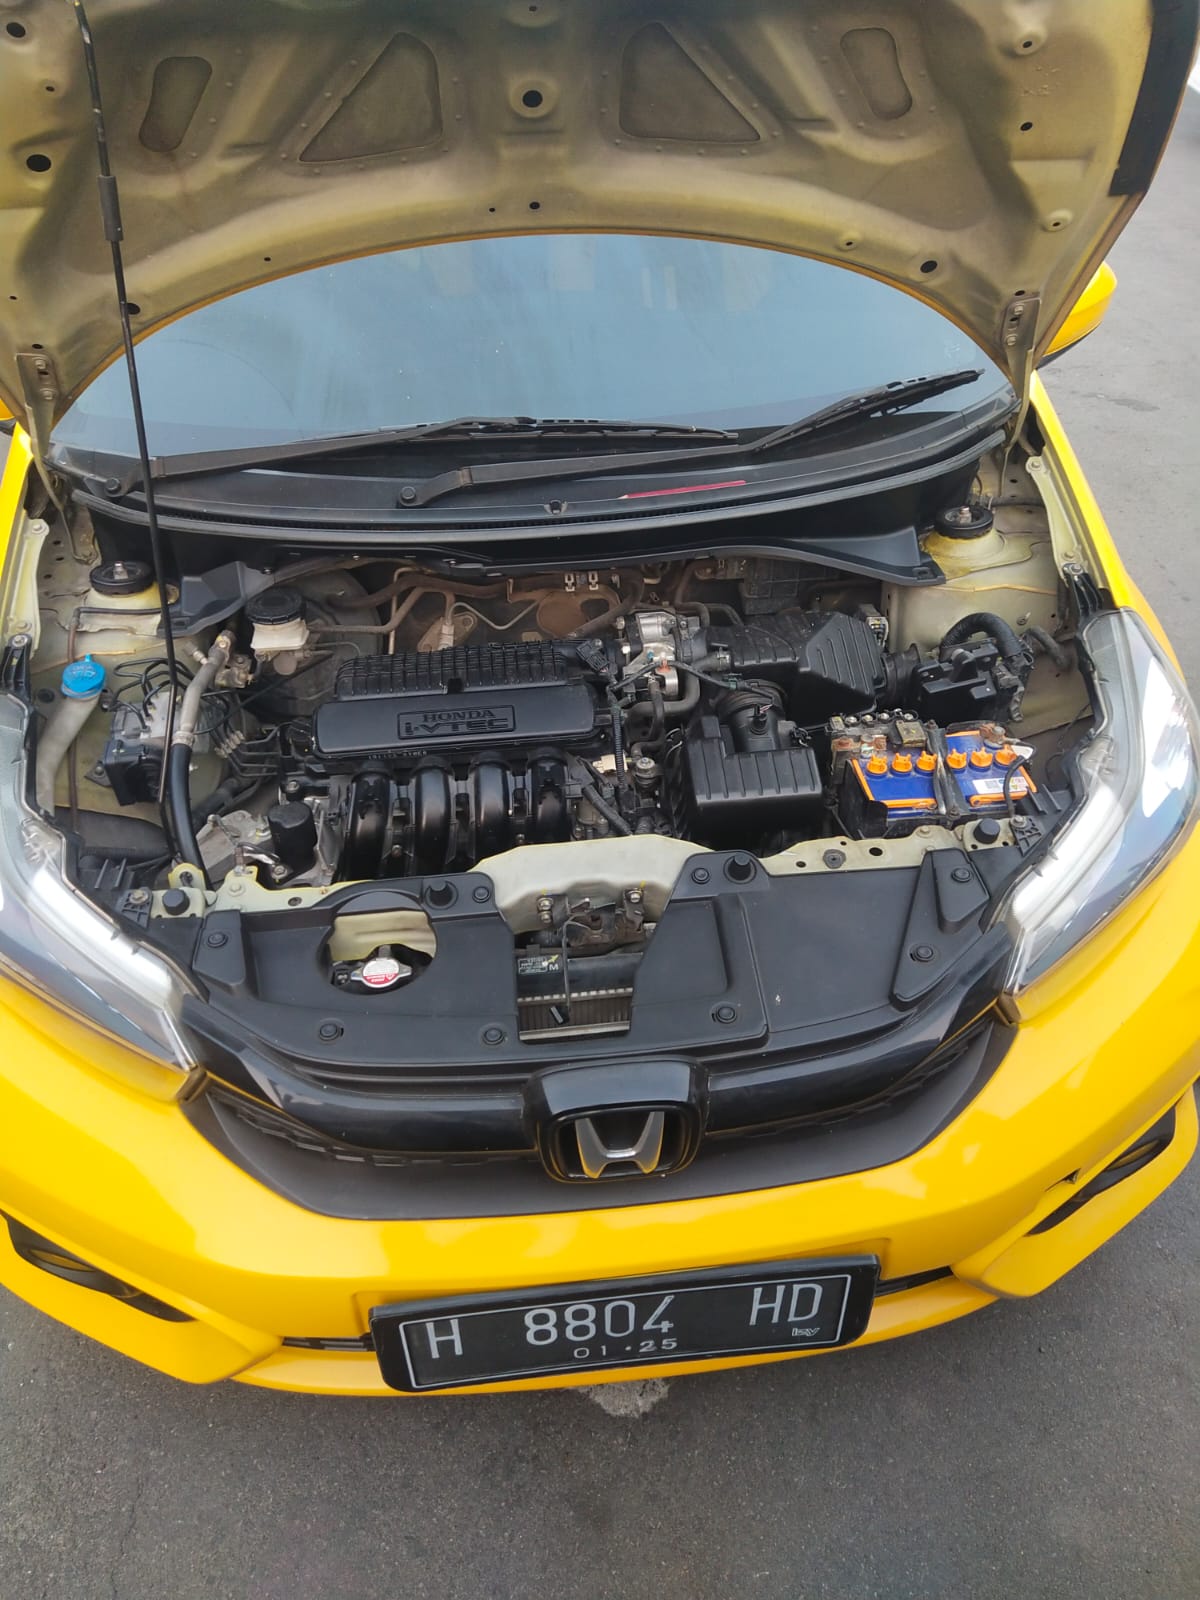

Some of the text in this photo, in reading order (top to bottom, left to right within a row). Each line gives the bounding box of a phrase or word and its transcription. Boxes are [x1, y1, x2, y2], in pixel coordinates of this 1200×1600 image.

[422, 709, 497, 723] HONDA
[549, 963, 559, 971] M
[425, 1283, 823, 1359] H 8804 HD
